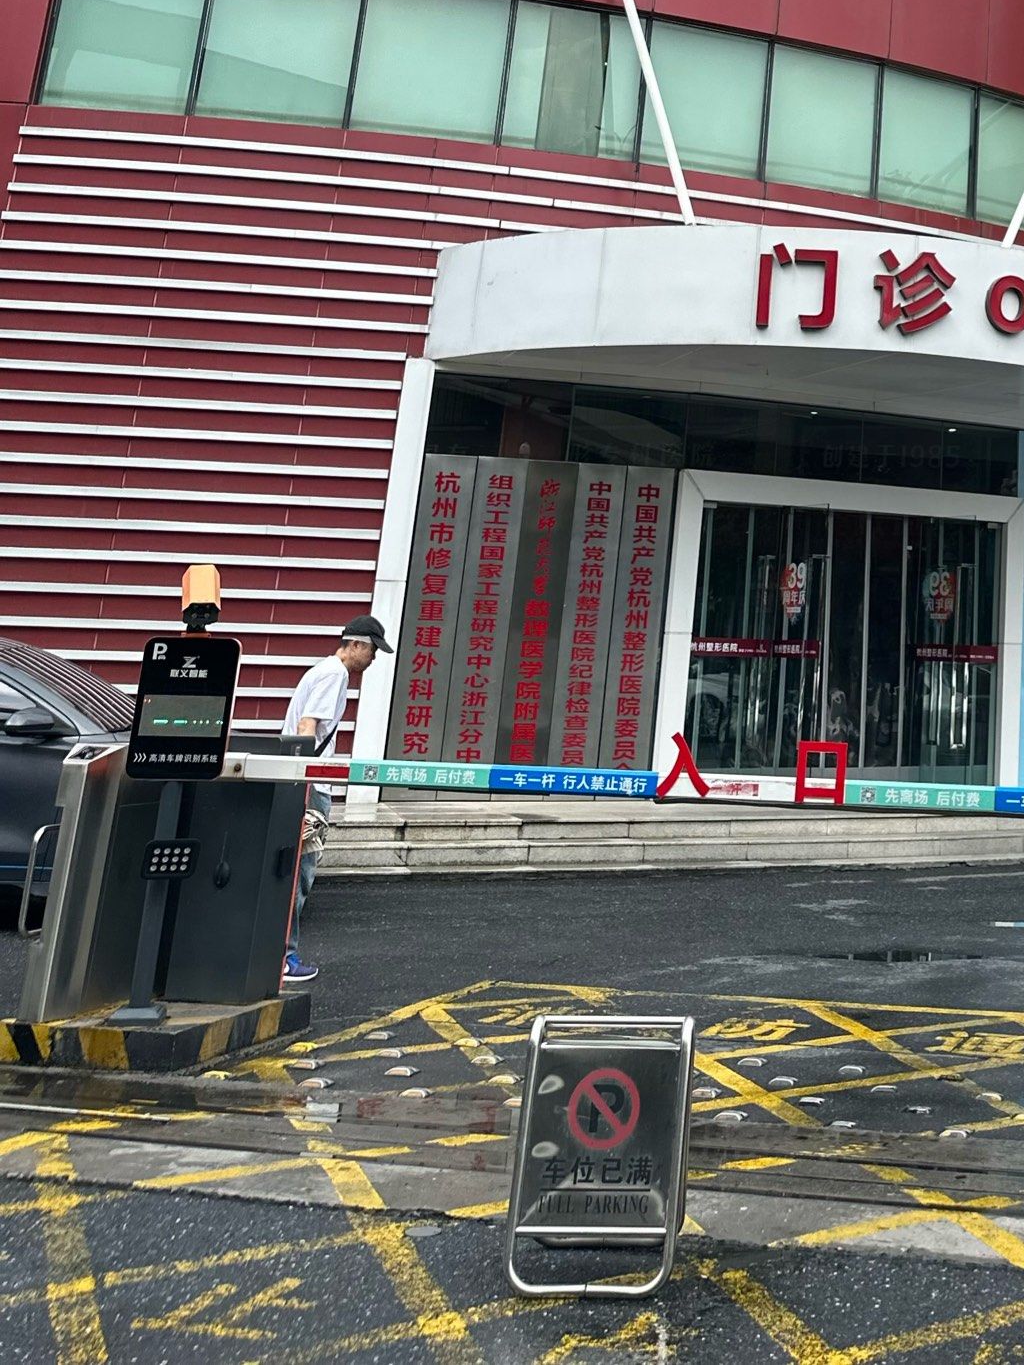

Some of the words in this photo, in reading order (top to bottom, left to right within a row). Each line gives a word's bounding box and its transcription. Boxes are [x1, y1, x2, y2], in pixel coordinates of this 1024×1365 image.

[756, 242, 956, 335] 门诊
[787, 562, 808, 591] 39
[402, 470, 462, 755] 杭州市修复重建外科研究
[612, 484, 661, 771] 中国共产党杭州整形医院委员
[148, 753, 218, 764] 高清车牌识别系统
[656, 731, 849, 805] 入口
[386, 766, 428, 784] 先离场
[434, 770, 477, 785] 后付费
[500, 772, 556, 789] 一车一杆
[562, 773, 648, 794] 行人禁止通行
[885, 787, 929, 805] 先离场
[936, 790, 980, 808] 后付费
[541, 1156, 653, 1186] 车位已满
[537, 1194, 575, 1214] FULL
[584, 1194, 650, 1215] PARKING
